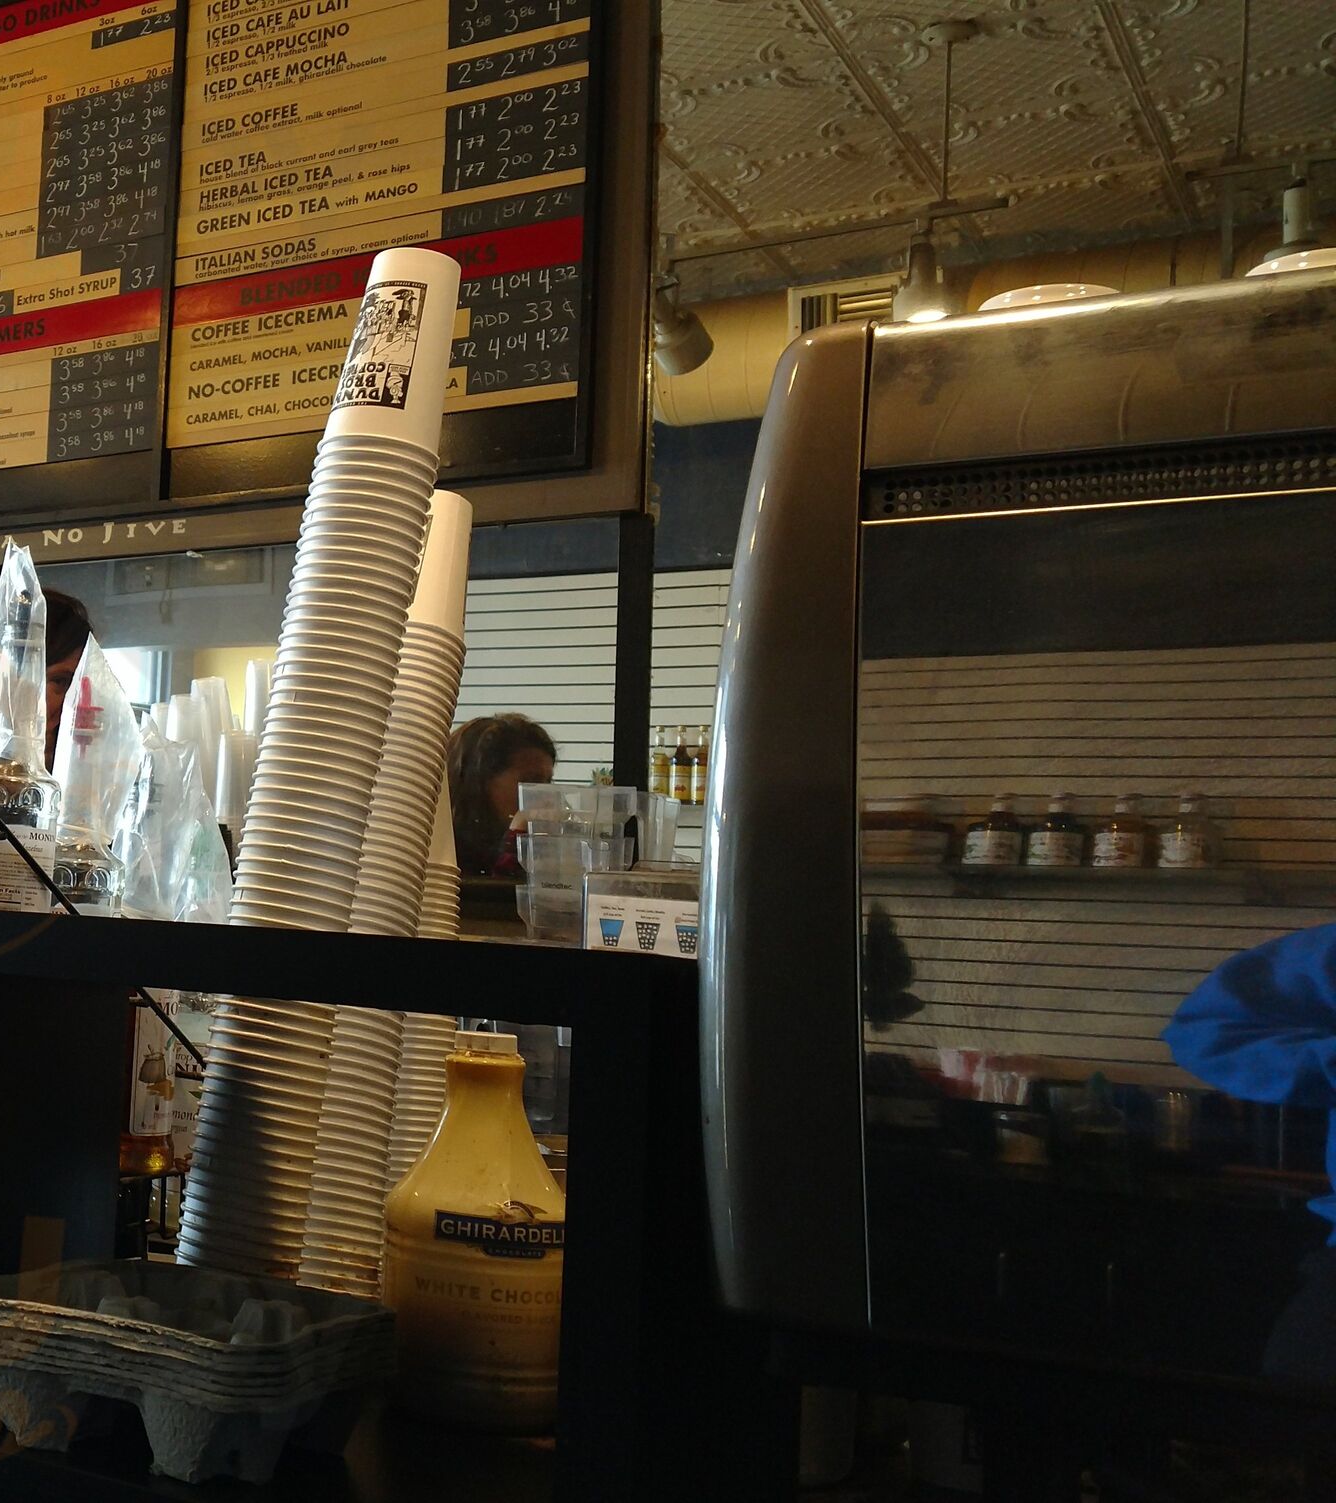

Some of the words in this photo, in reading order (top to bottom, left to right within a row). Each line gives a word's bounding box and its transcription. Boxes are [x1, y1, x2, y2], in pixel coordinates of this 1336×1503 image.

[206, 24, 240, 42] ICED
[246, 11, 283, 32] CAFE
[288, 4, 311, 22] AU
[316, 0, 349, 15] LAIT
[205, 50, 240, 69] ICED
[245, 23, 350, 59] CAPPUCCINO
[204, 78, 238, 96] ICED
[242, 66, 280, 87] CAFE
[285, 51, 348, 78] MOCHA
[202, 118, 236, 136] ICED
[242, 103, 298, 127] COFFEE
[199, 158, 233, 177] ICED
[238, 151, 267, 168] TEA
[200, 174, 224, 184] house
[225, 168, 249, 180] blend
[251, 166, 260, 175] of
[262, 160, 284, 171] black
[286, 153, 317, 166] currant
[319, 149, 336, 159] and
[338, 144, 356, 155] earl
[358, 141, 378, 152] grey
[380, 136, 399, 147] teas
[200, 182, 258, 204] HERBAL
[264, 172, 298, 191] ICED
[304, 165, 334, 182] TEA
[196, 212, 251, 235] GREEN
[256, 204, 294, 223] ICED
[299, 196, 330, 214] TEA
[336, 195, 359, 208] with
[364, 182, 418, 203] MANGO
[195, 250, 256, 272] ITALIAN
[261, 238, 317, 258] SODAS
[16, 293, 44, 306] Extra
[48, 286, 74, 300] Shot
[78, 276, 117, 294] SYRUP
[191, 320, 250, 342] COFFEE
[258, 304, 348, 331] ICECREMA
[472, 312, 510, 329] ADD
[522, 300, 553, 324] 33
[190, 354, 248, 372] CARAMEL,
[251, 346, 302, 362] MOCHA,
[306, 337, 350, 353] VANILL
[188, 372, 280, 400] NO-COFFEE
[186, 409, 244, 424] CARAMEL,
[248, 402, 280, 416] CHAI,
[42, 528, 83, 546] NO
[102, 518, 186, 544] JIVE
[440, 1219, 564, 1244] GHIRARDEL
[416, 1276, 480, 1300] WHITE
